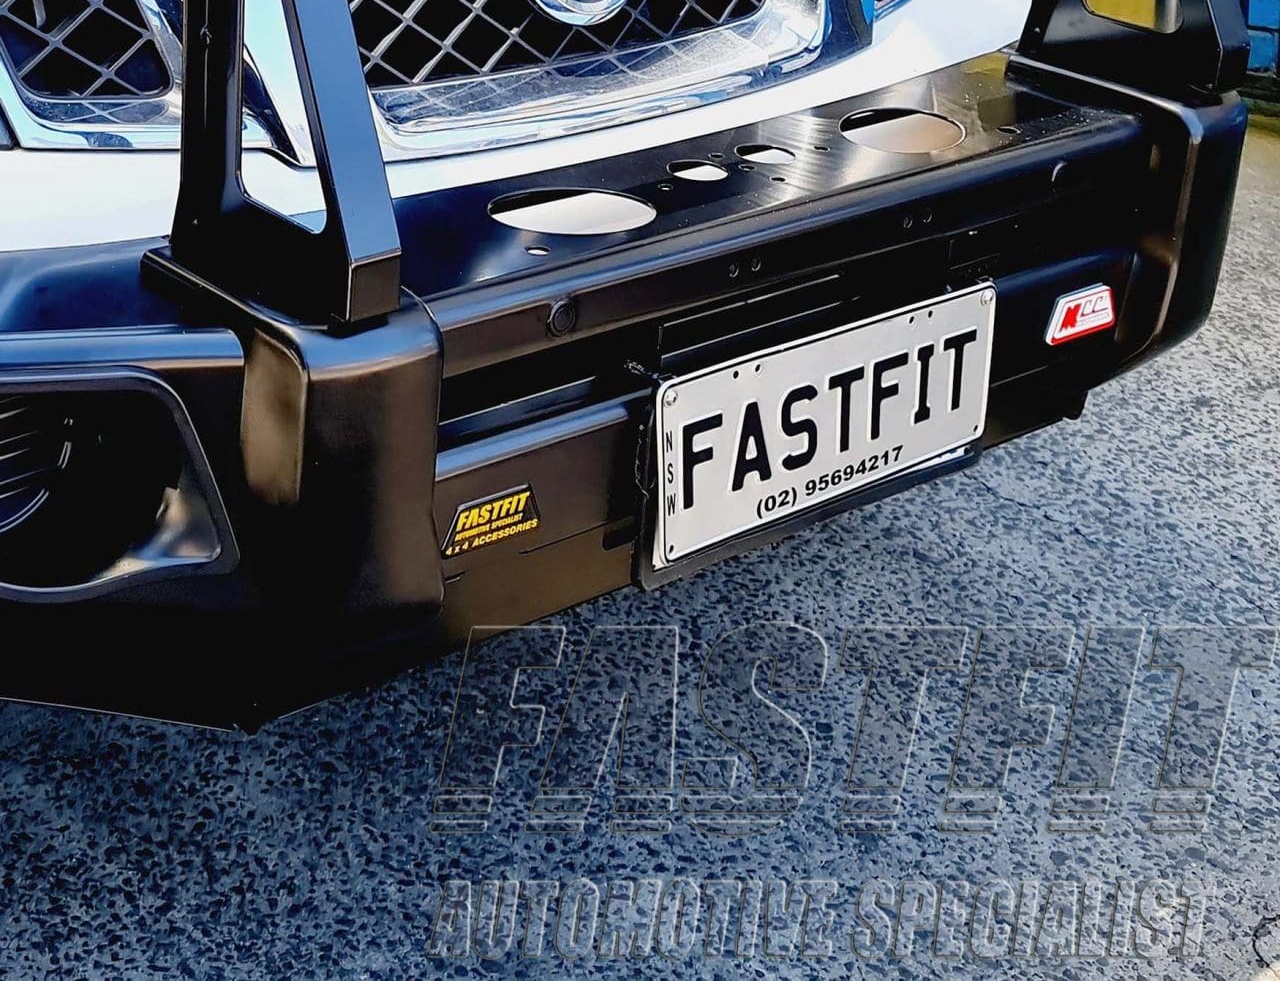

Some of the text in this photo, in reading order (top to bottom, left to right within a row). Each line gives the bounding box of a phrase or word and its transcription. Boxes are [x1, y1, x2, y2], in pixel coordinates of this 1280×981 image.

[683, 328, 978, 510] FASTFIT
[756, 444, 904, 519] (02) 95694217
[455, 491, 531, 532] FASTFIT
[471, 518, 538, 548] ACCESSORIES
